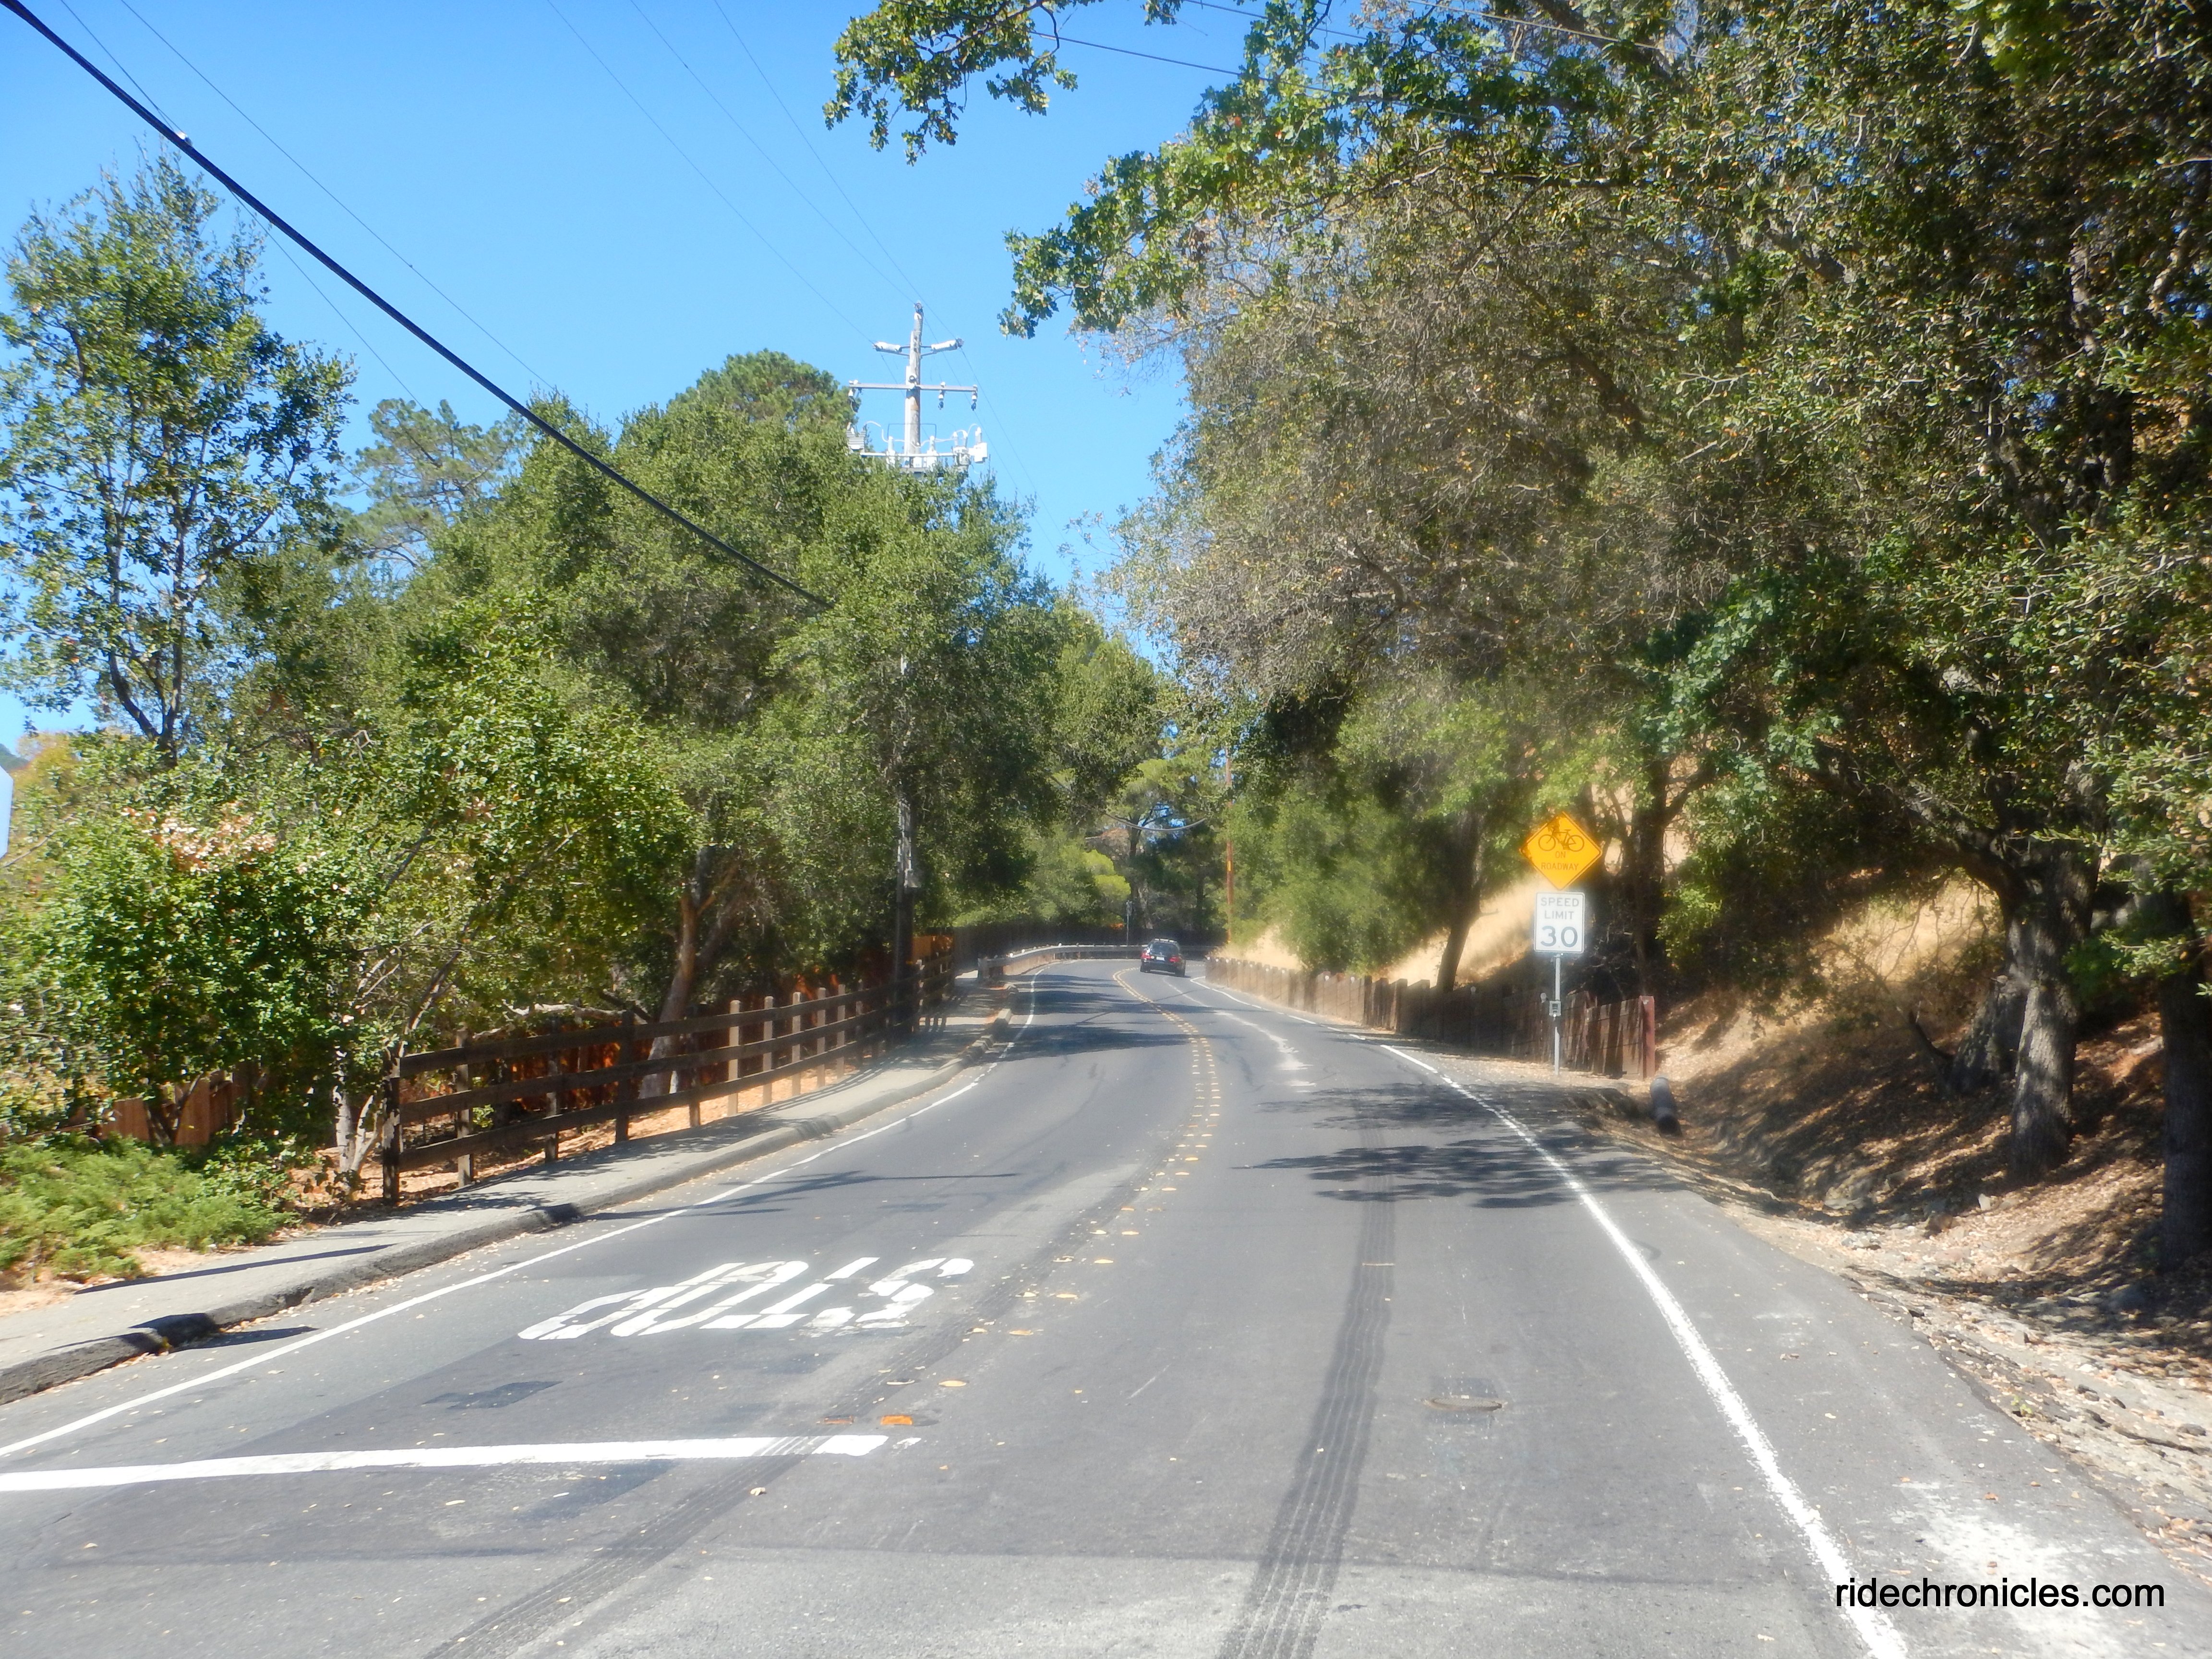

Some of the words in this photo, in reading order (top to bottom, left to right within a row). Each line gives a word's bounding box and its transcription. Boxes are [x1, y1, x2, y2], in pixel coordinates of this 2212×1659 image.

[1541, 863, 1578, 871] ROADWAY
[1540, 897, 1579, 907] SPEED
[1544, 910, 1575, 920] LIMIT
[1540, 926, 1578, 948] 30
